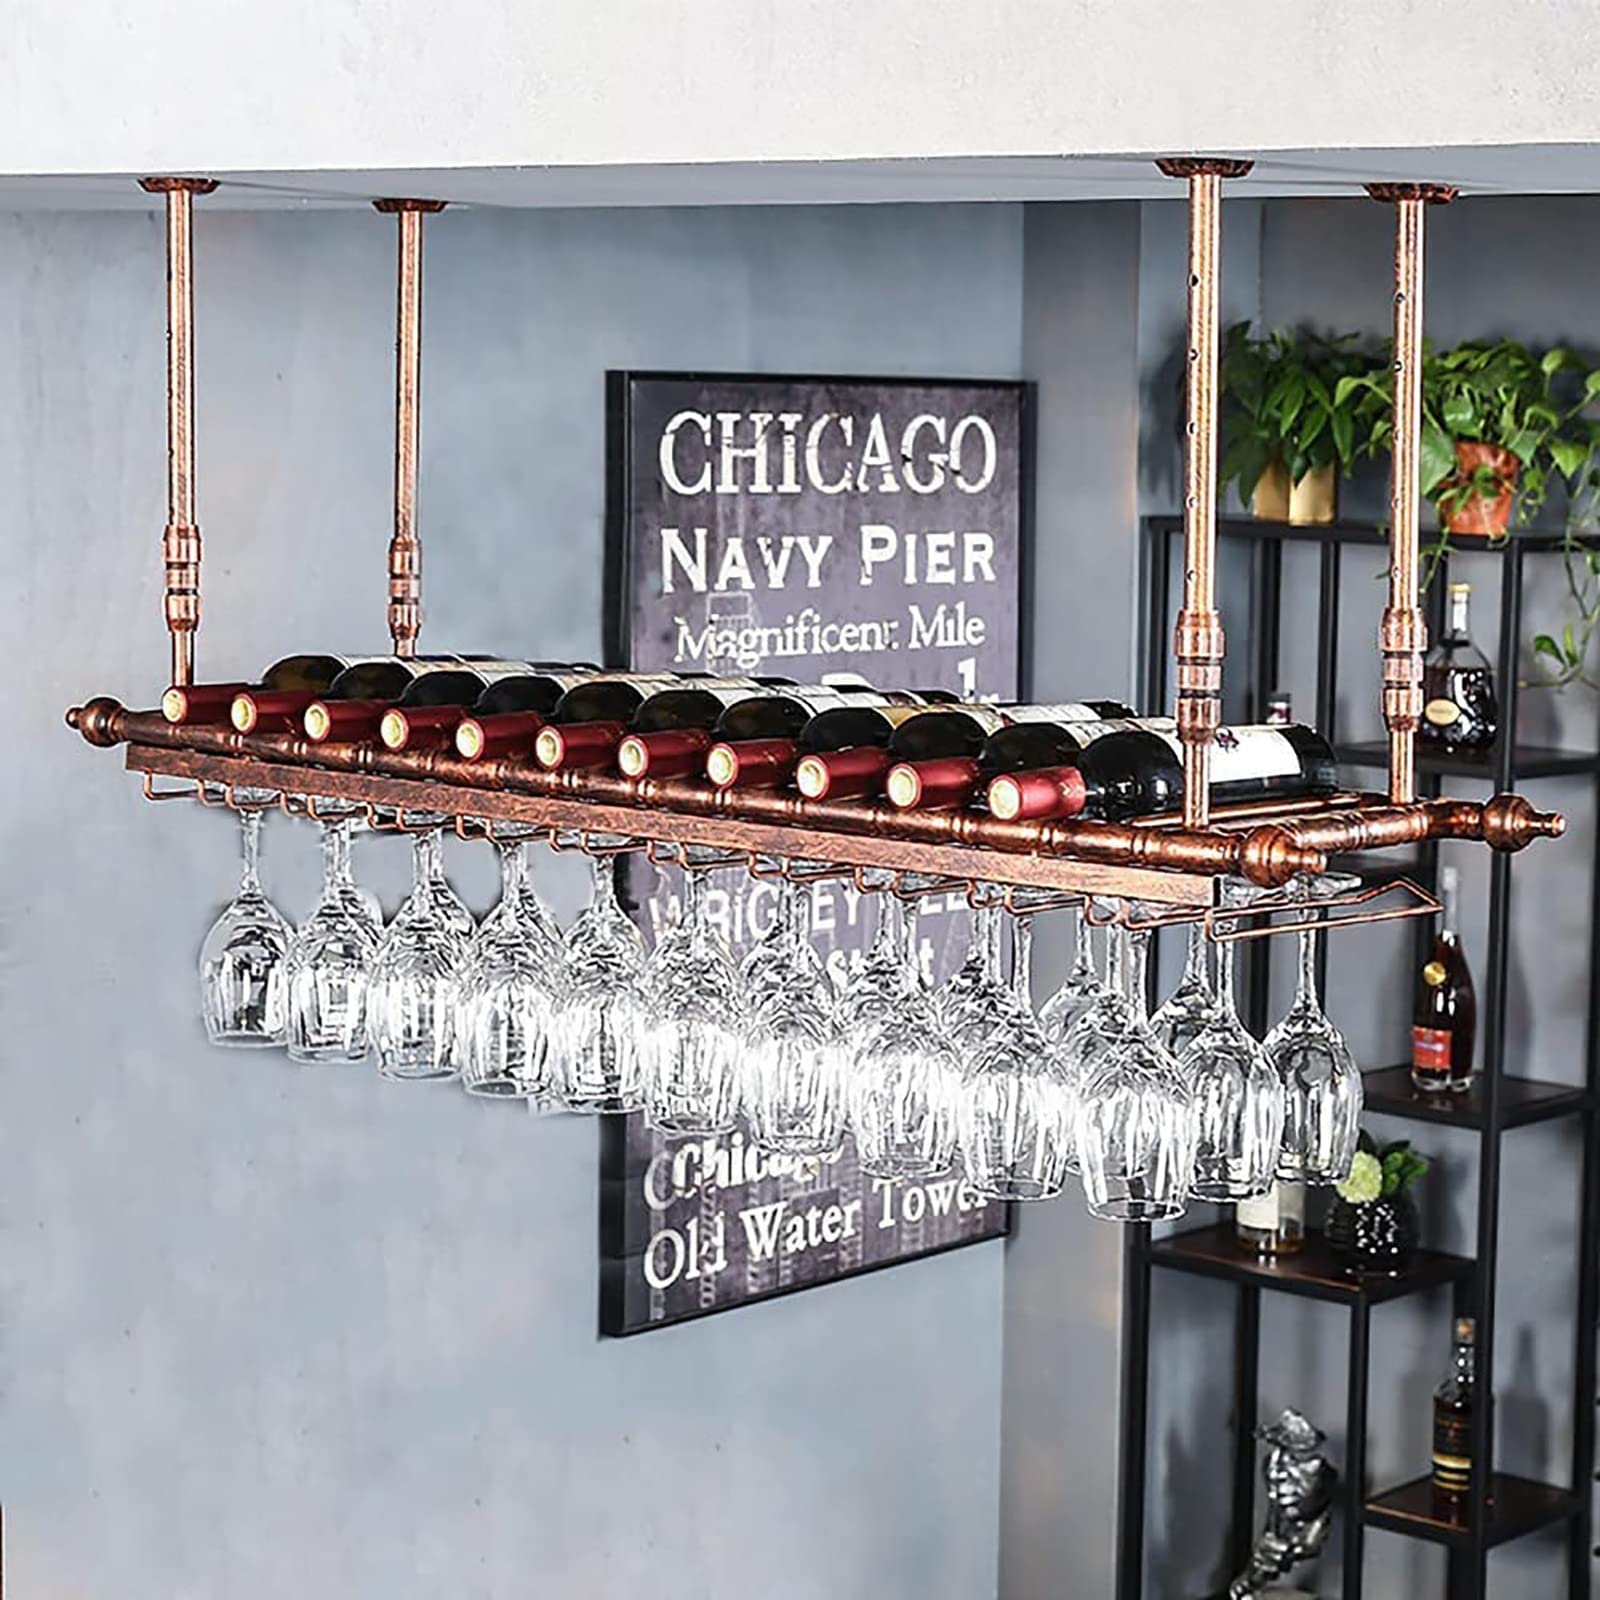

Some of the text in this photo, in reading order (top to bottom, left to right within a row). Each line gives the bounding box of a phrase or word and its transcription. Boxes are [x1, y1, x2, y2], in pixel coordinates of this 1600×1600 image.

[659, 411, 997, 495] CHICAGO
[660, 525, 996, 593] NAVY PIER
[908, 601, 985, 648] Mile
[738, 1200, 862, 1262] Water
